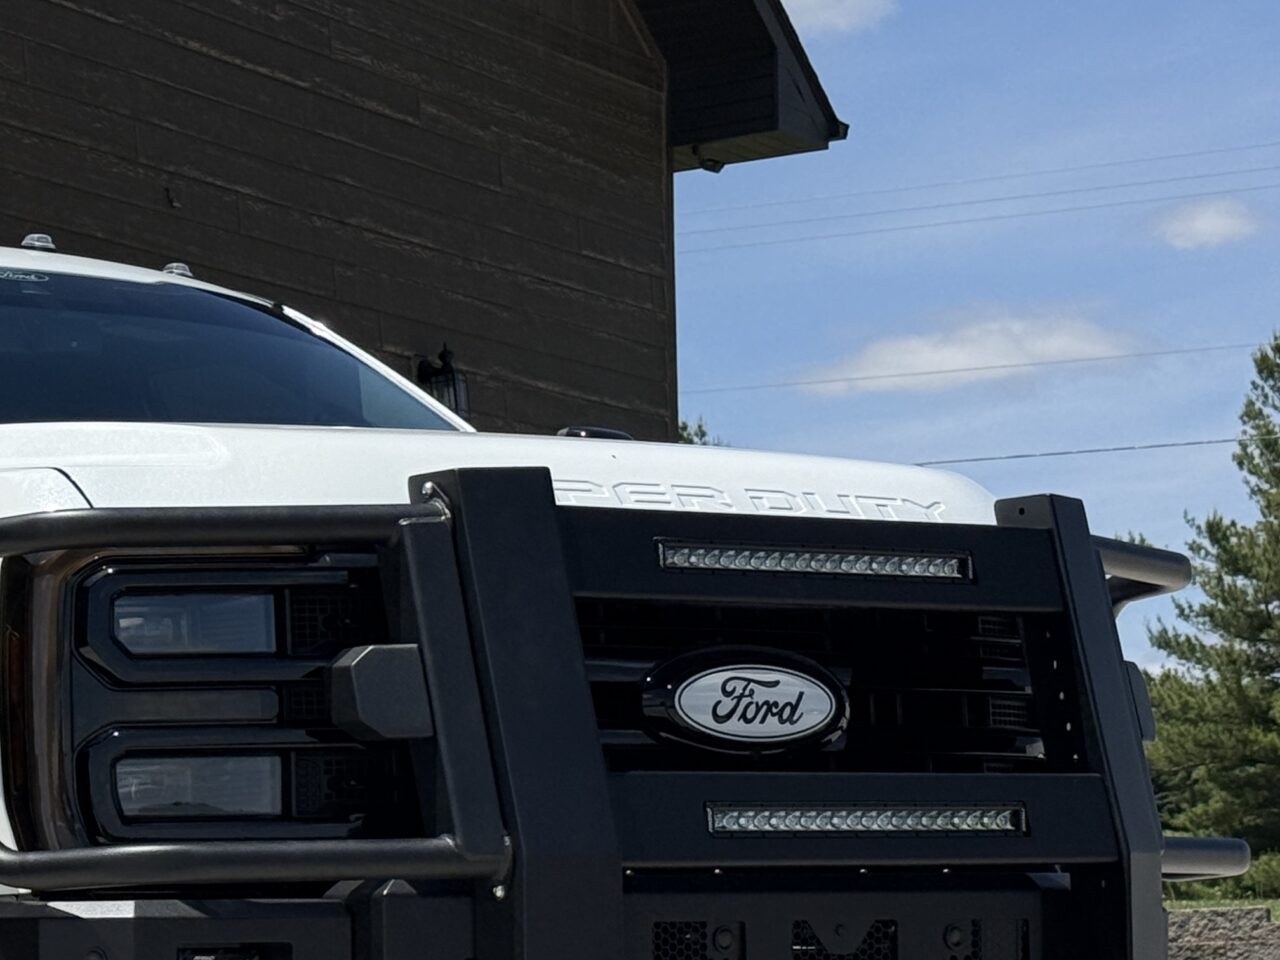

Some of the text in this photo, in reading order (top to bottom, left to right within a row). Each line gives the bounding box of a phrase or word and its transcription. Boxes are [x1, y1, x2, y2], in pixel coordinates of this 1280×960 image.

[552, 479, 947, 521] PER DUTY
[711, 676, 805, 725] Ford
